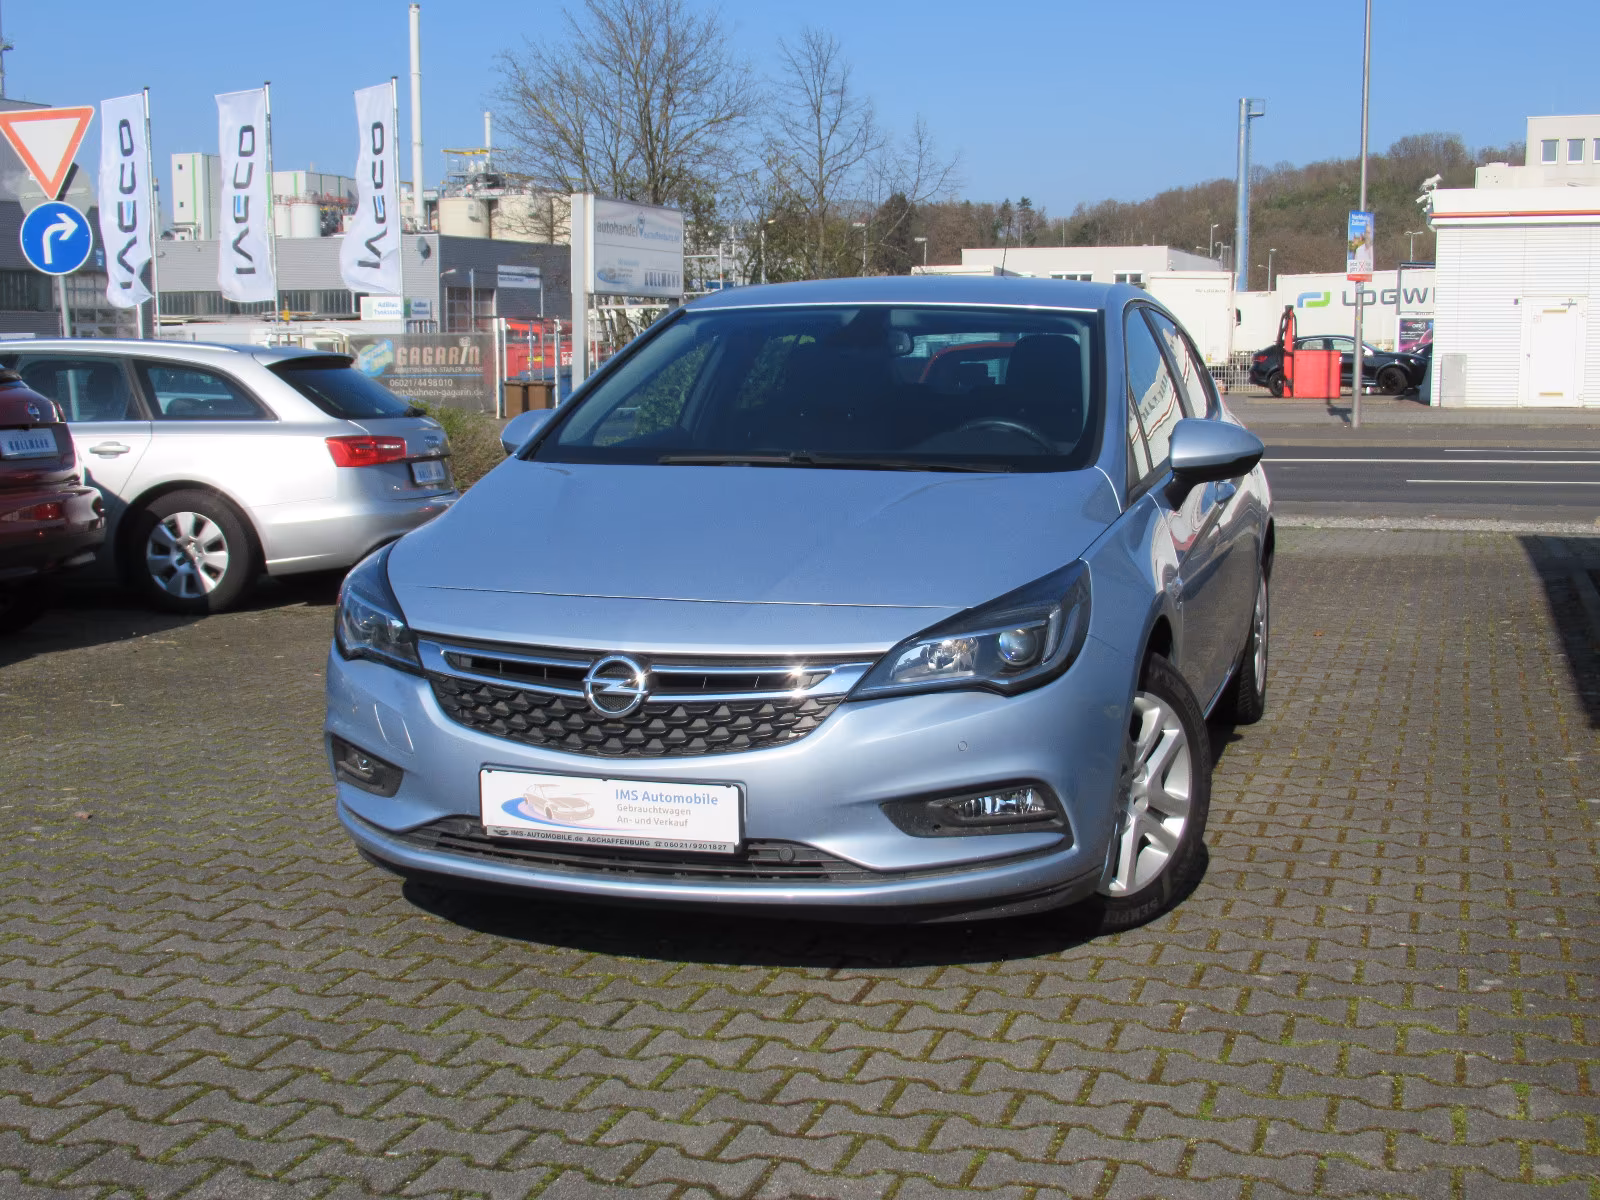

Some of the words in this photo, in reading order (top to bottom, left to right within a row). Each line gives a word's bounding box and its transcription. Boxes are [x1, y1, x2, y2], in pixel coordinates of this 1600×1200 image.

[231, 124, 256, 275] IVECO
[357, 120, 388, 270] IVECO
[615, 788, 639, 801] IMS
[642, 792, 719, 806] Automobile
[616, 803, 692, 817] Gebrauchtwagen
[616, 815, 633, 825] An-
[635, 816, 652, 825] und
[654, 817, 689, 828] Verkauf
[586, 836, 651, 847] ASCHAFFENBURG
